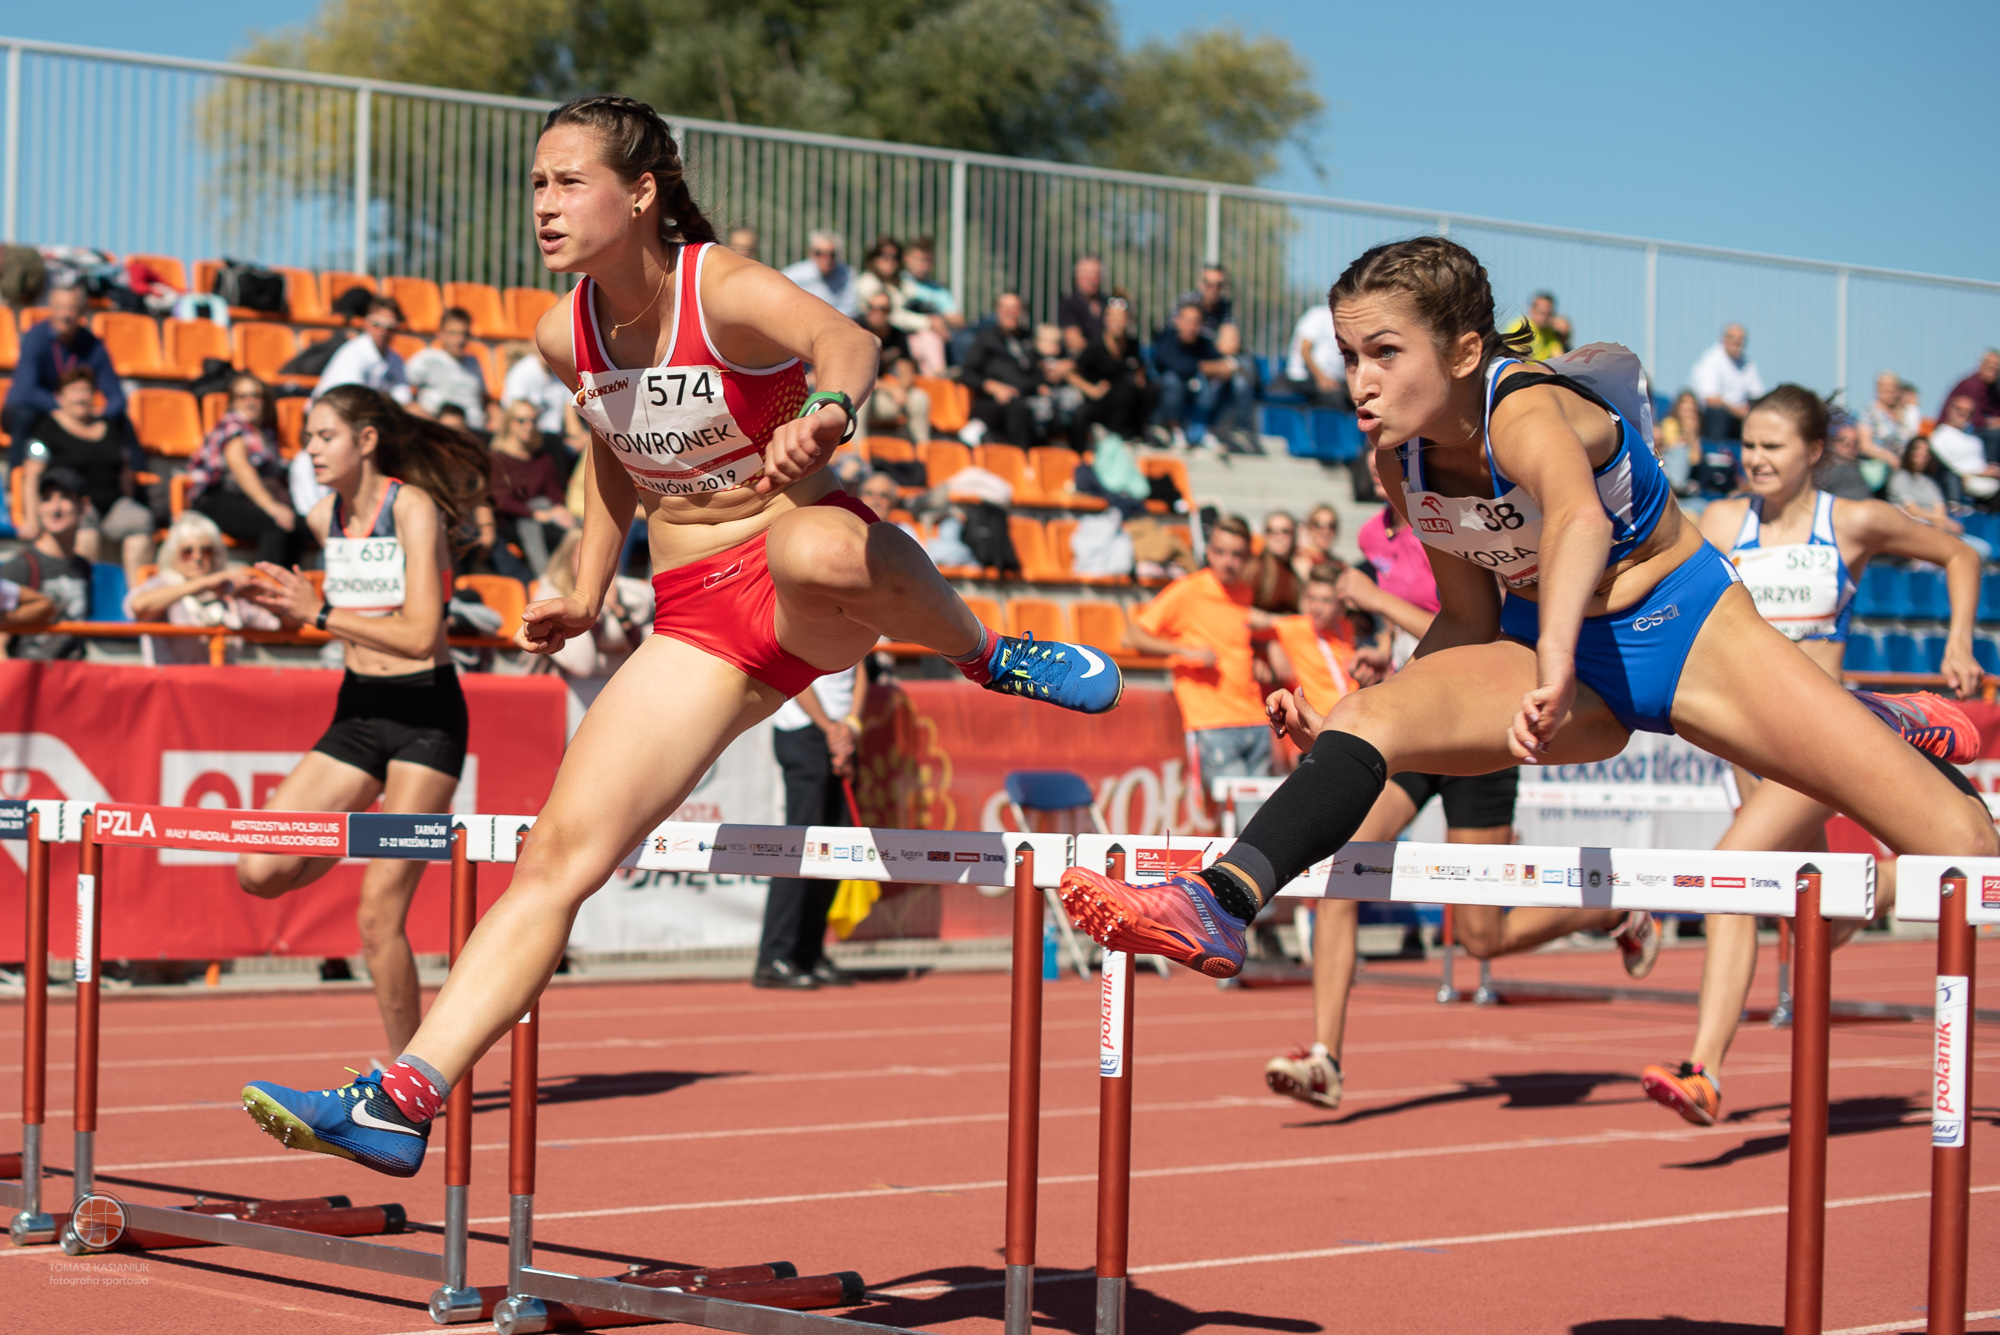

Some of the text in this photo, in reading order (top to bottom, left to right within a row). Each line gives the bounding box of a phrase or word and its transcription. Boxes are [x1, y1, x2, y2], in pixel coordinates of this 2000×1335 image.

[647, 371, 715, 407] 574
[595, 423, 737, 456] KOWRONEK
[697, 469, 737, 492] 2019
[1421, 519, 1451, 533] RLEN
[1475, 502, 1525, 532] 38
[360, 542, 398, 562] 637
[96, 809, 157, 838] PZLA
[231, 819, 340, 833] MISTRZOSTWA POLSKI U16
[414, 822, 447, 836] TARNÓW
[231, 833, 271, 845] JANUSZA
[271, 834, 340, 847] KUSOCIŃSKIEGO
[379, 837, 398, 848] 21-22
[430, 838, 447, 848] 2019
[1137, 852, 1160, 860] PZLA
[1191, 895, 1220, 936] RACING
[1101, 971, 1115, 1051] polanik
[1935, 1019, 1955, 1115] polanik
